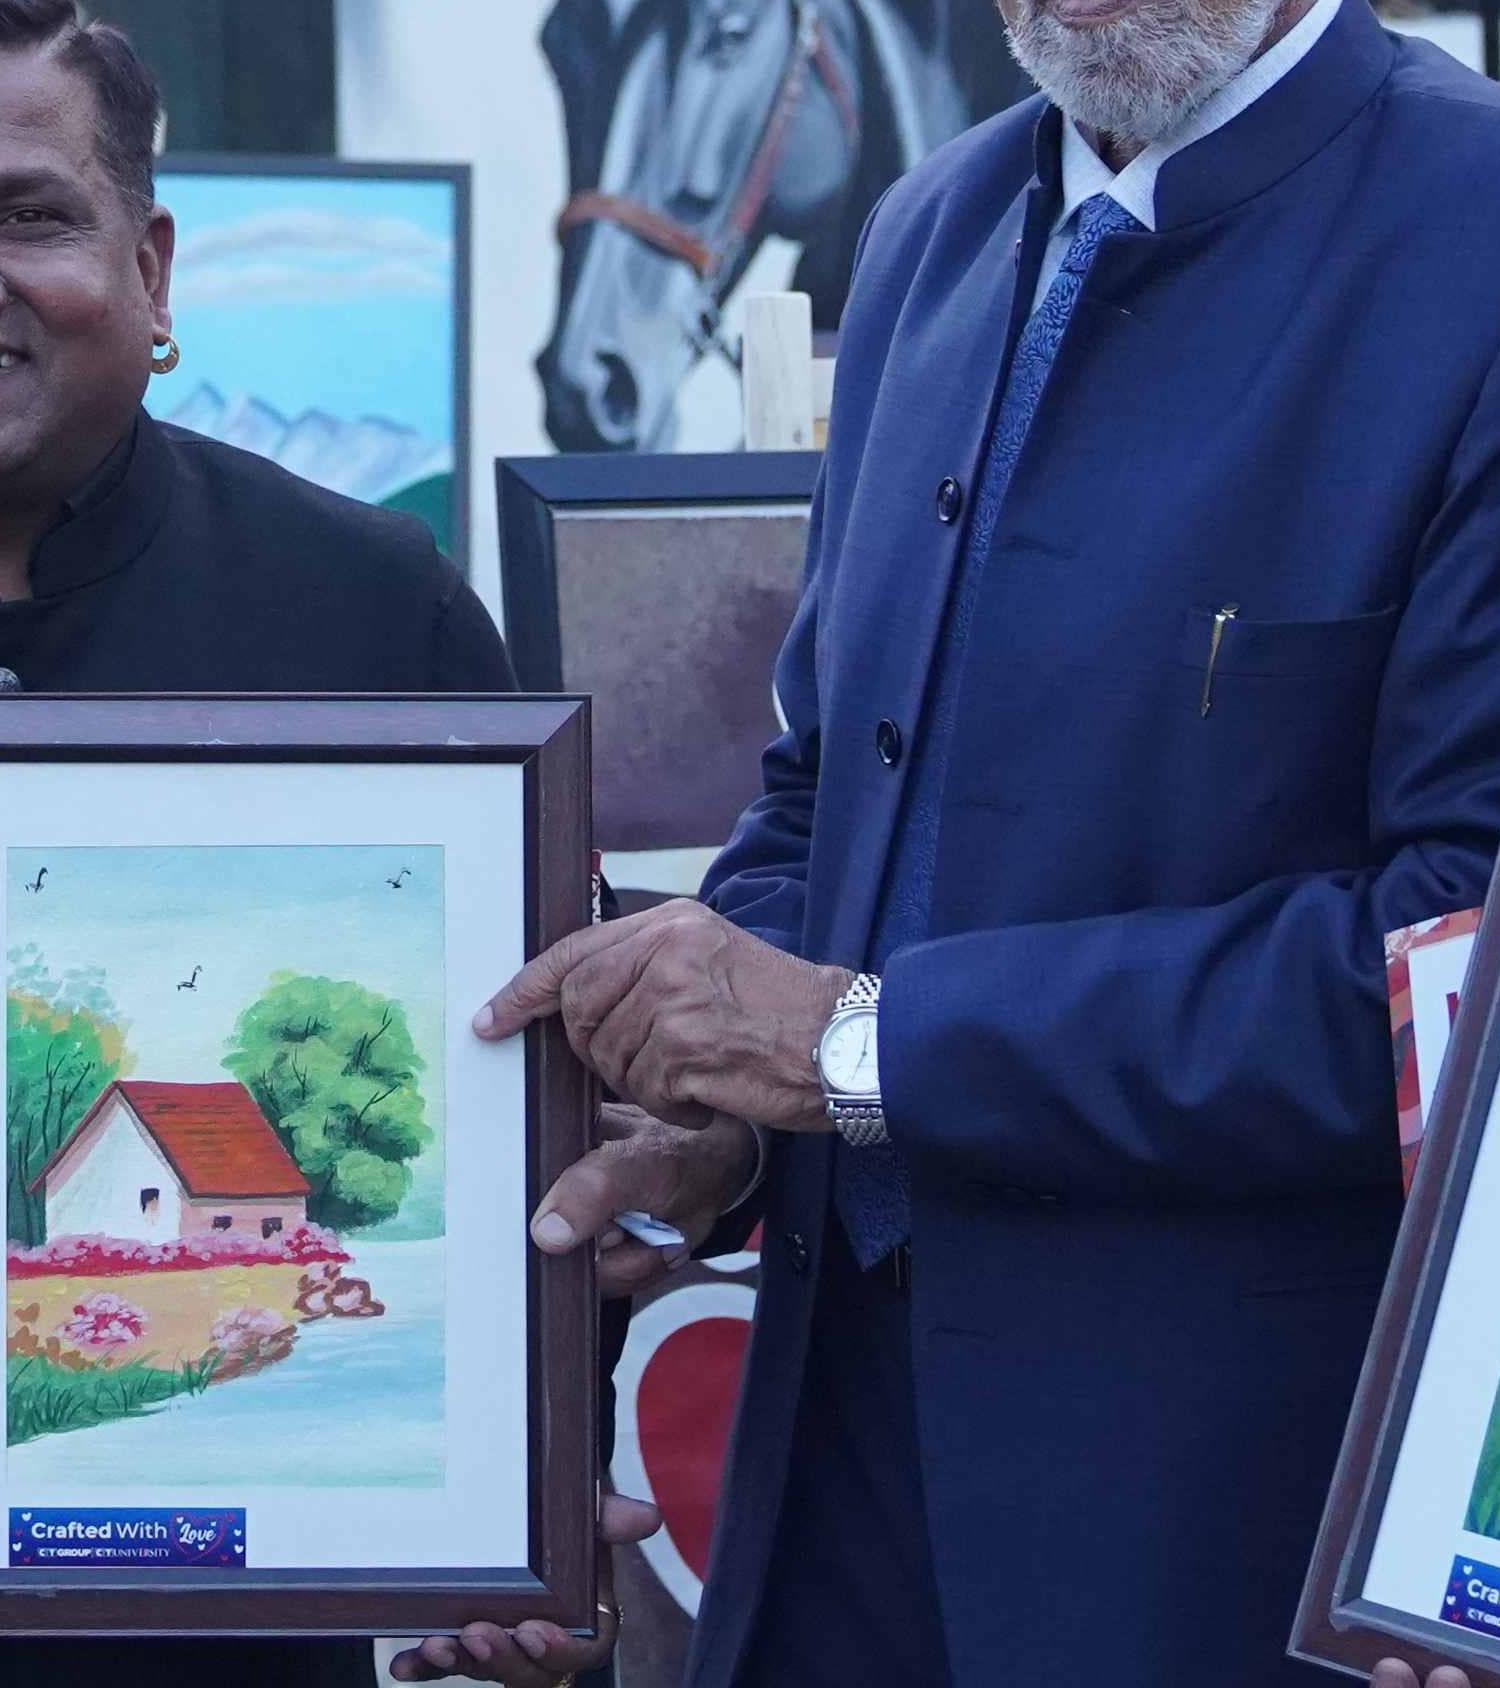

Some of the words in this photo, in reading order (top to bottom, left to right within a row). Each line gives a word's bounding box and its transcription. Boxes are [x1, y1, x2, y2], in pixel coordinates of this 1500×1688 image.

[31, 1521, 111, 1539] Crafted
[115, 1521, 167, 1539] With
[179, 1523, 216, 1544] Love
